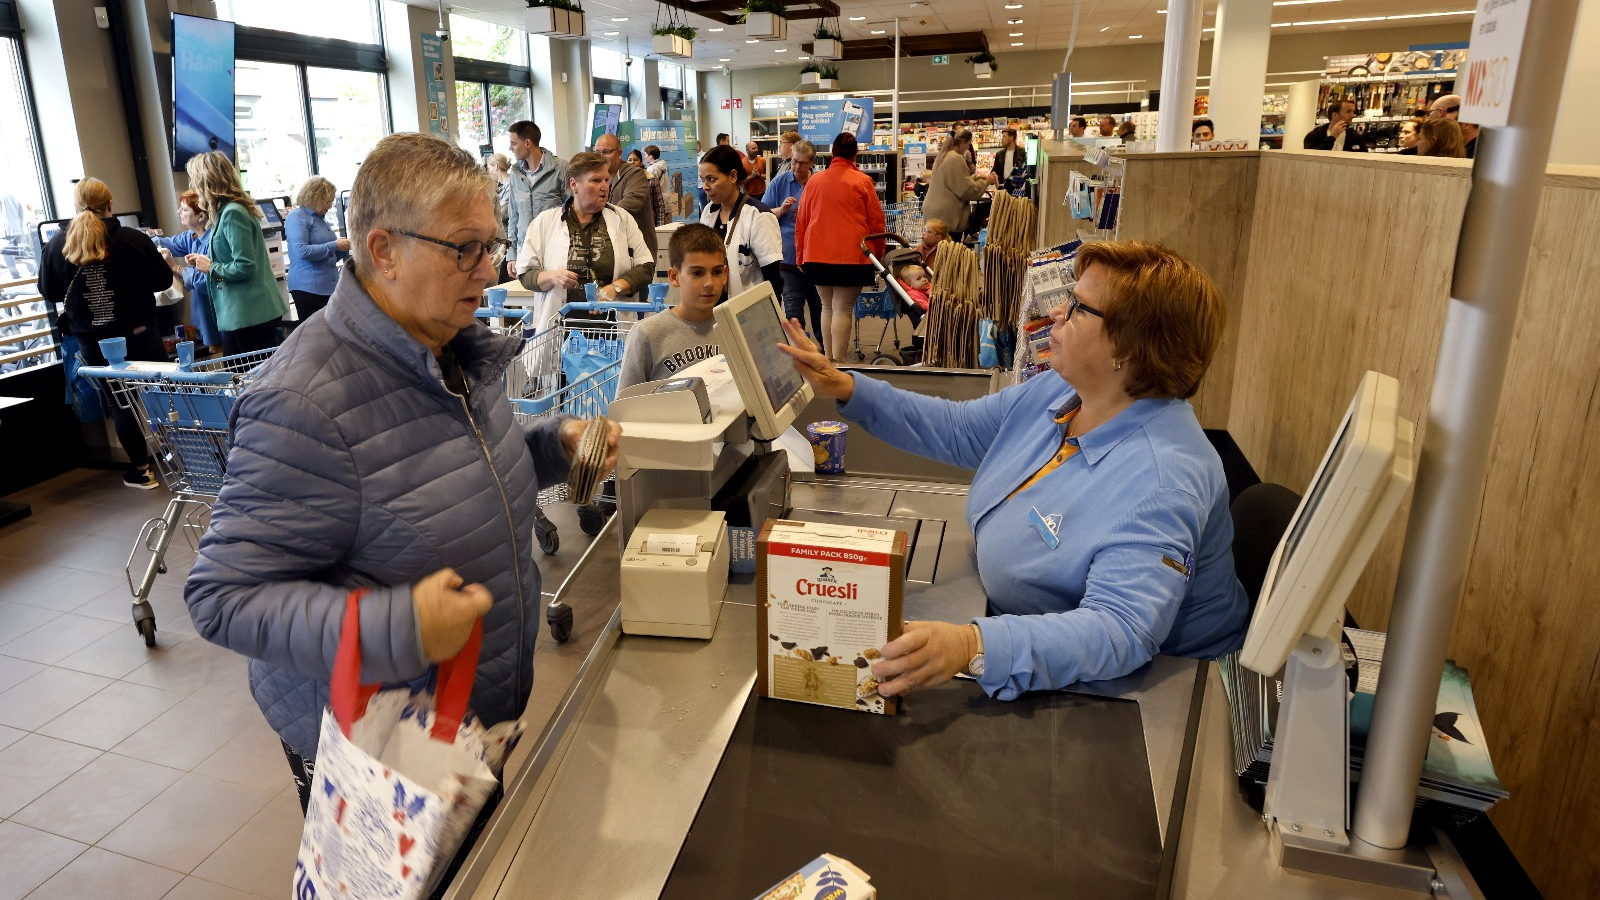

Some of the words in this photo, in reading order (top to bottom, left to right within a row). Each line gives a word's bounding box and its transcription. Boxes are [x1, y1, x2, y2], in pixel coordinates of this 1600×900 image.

[739, 529, 747, 538] Je
[739, 538, 747, 559] nieuwe
[790, 547, 819, 557] FAMILY
[820, 550, 842, 559] PACK
[796, 578, 858, 600] Cruesli
[811, 598, 843, 606] CHOCOLATE
